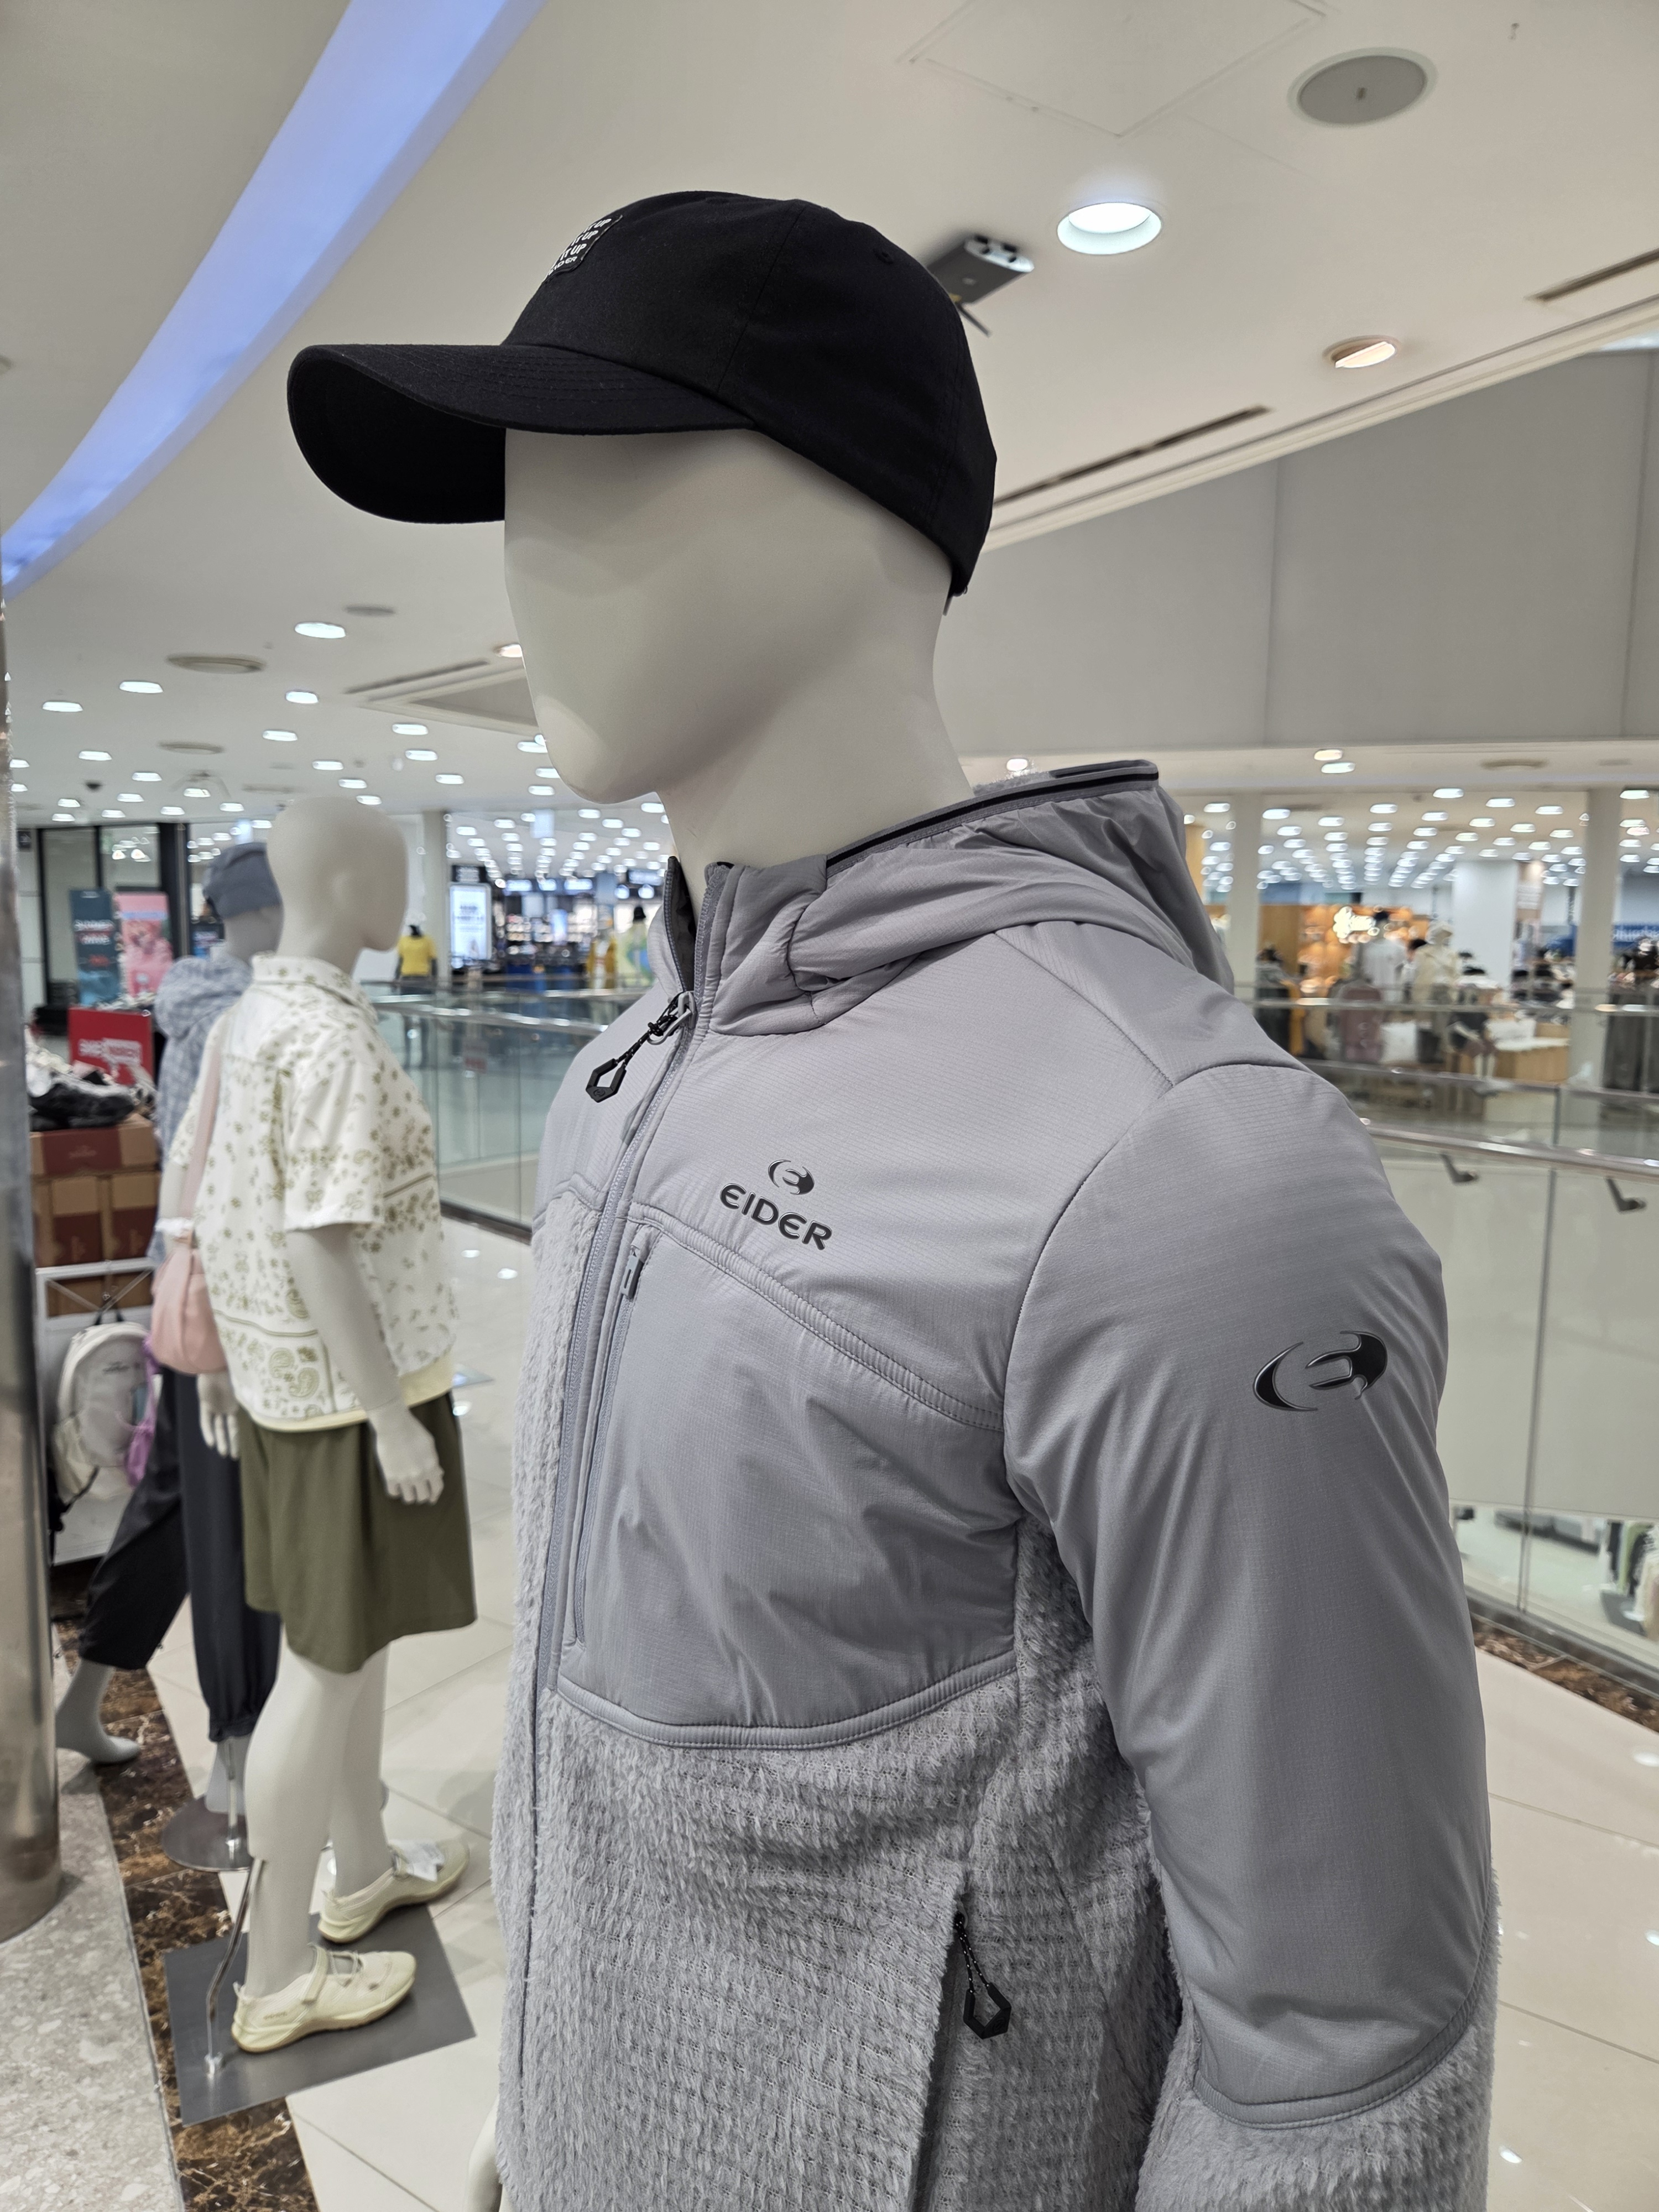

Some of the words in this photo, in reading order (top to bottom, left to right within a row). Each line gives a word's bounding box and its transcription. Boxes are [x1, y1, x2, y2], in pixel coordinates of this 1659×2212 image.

[594, 218, 612, 228] UP
[571, 234, 583, 247] IT
[582, 230, 598, 241] UP
[560, 248, 572, 261] IT
[570, 243, 587, 255] UP
[719, 1183, 833, 1251] EIDER
